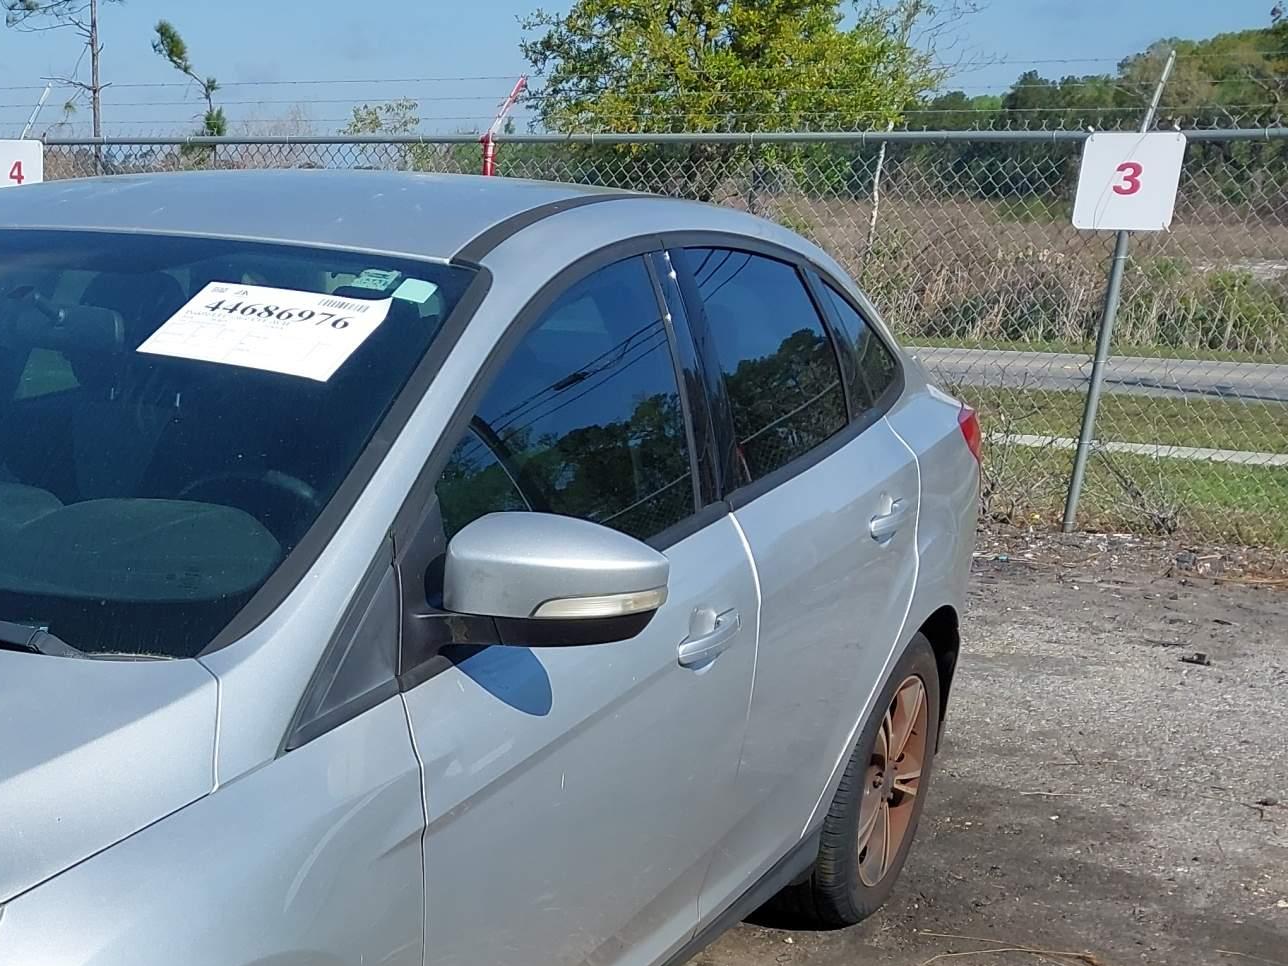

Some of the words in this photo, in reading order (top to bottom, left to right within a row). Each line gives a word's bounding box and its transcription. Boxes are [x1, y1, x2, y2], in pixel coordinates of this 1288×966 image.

[9, 161, 25, 184] 4
[1112, 161, 1143, 196] 3
[204, 298, 356, 330] 44686976
